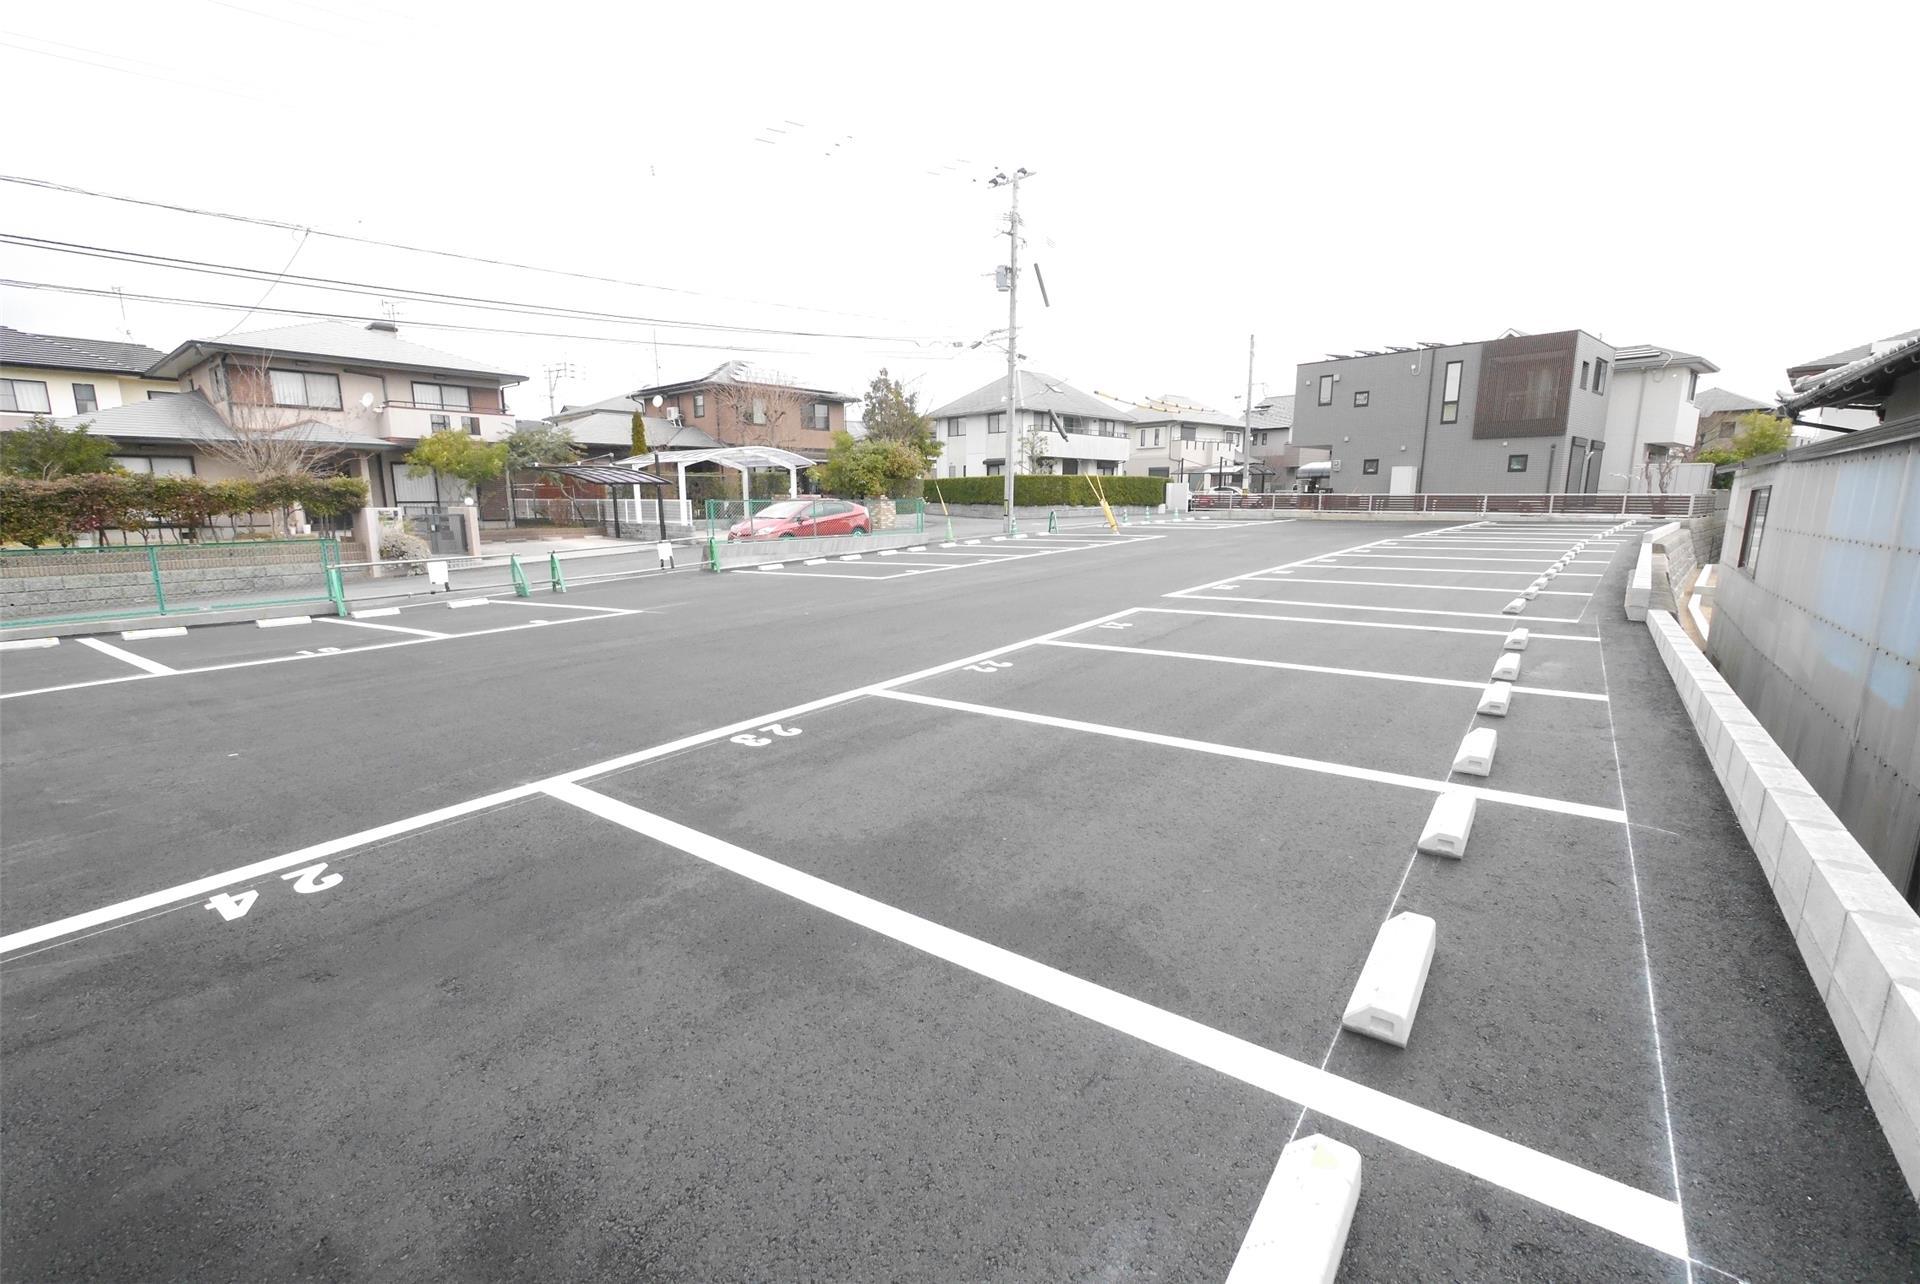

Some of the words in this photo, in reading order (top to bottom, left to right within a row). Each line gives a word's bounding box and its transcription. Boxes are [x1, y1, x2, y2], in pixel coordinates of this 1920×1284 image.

[962, 659, 1013, 673] 22
[729, 723, 803, 747] 23
[204, 862, 344, 922] 24
